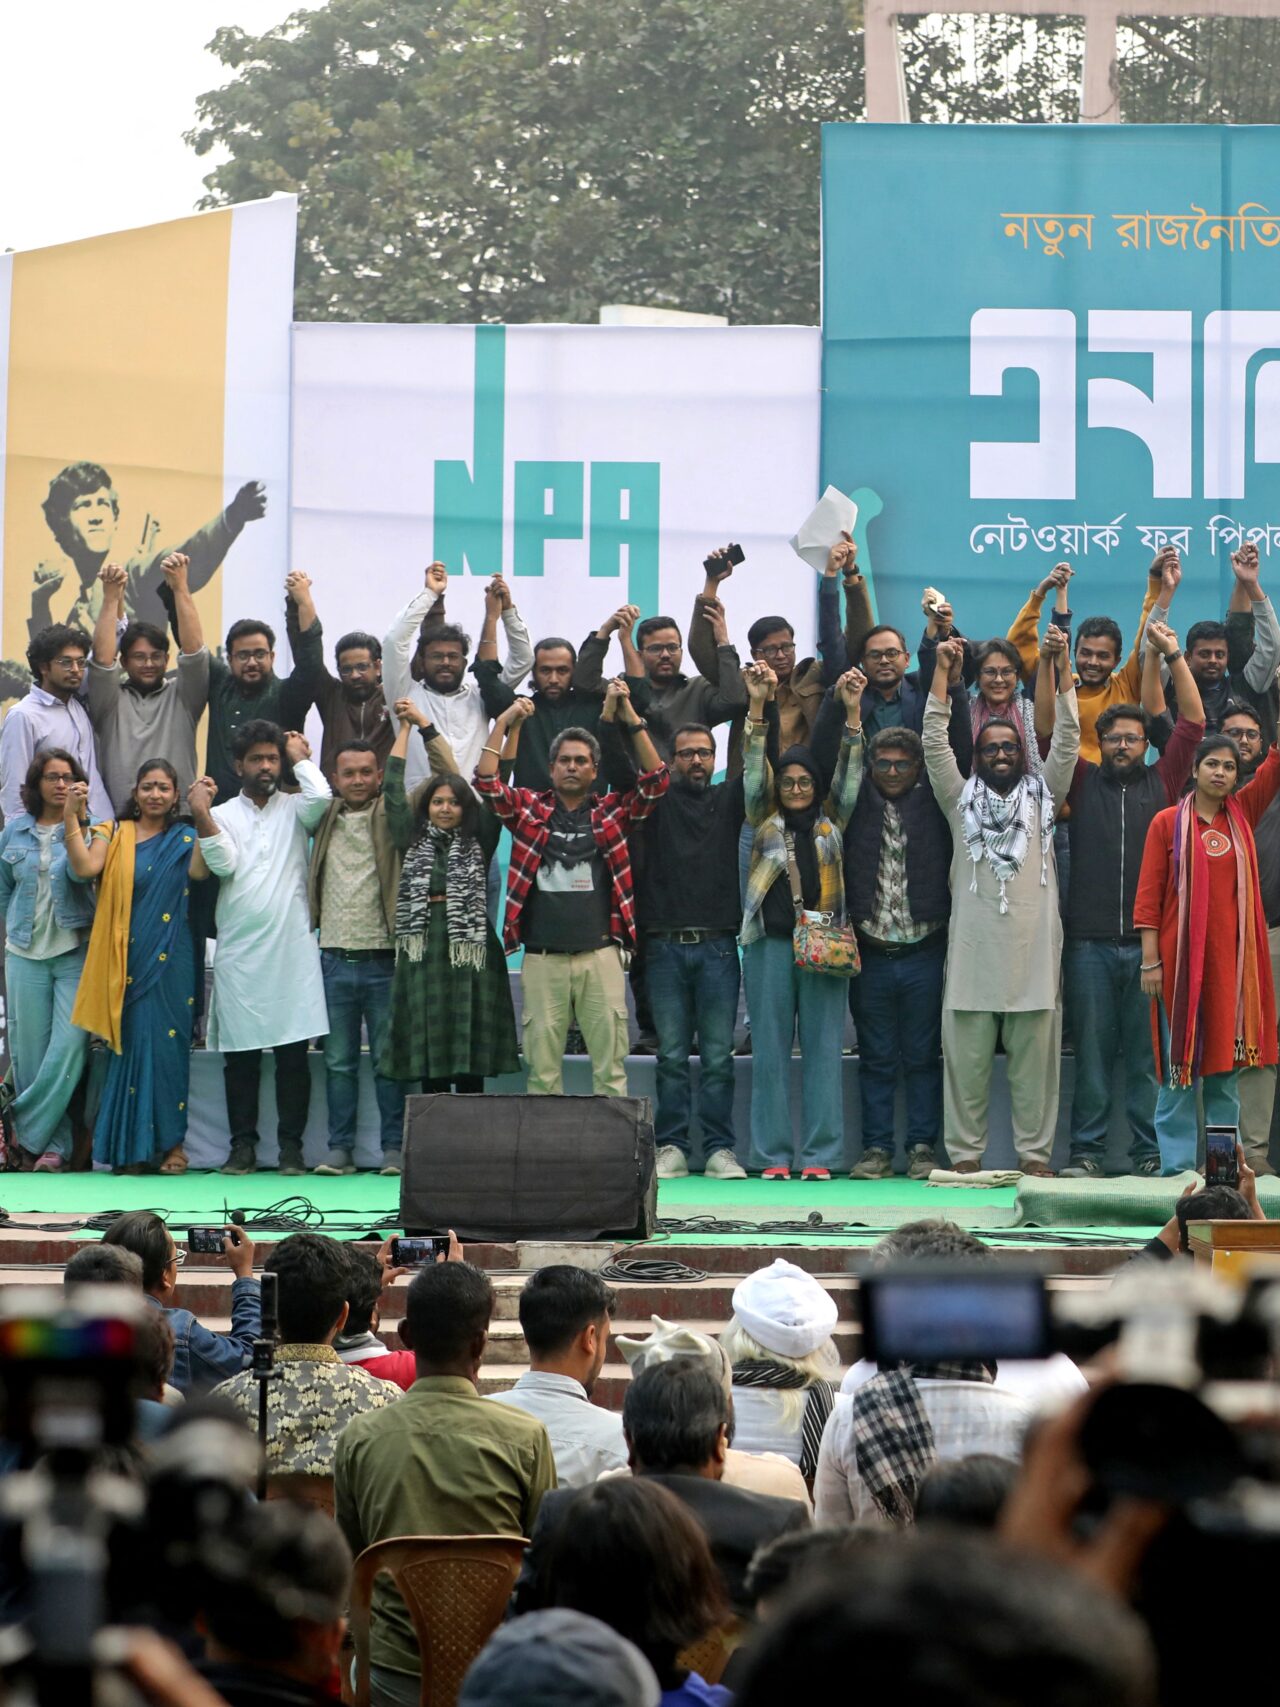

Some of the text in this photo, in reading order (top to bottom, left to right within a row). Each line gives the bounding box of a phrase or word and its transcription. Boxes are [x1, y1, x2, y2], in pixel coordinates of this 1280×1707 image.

[1000, 212, 1095, 259] নতুন
[970, 513, 1127, 555] নেটওয়ার্ক
[1136, 526, 1193, 556] ফর
